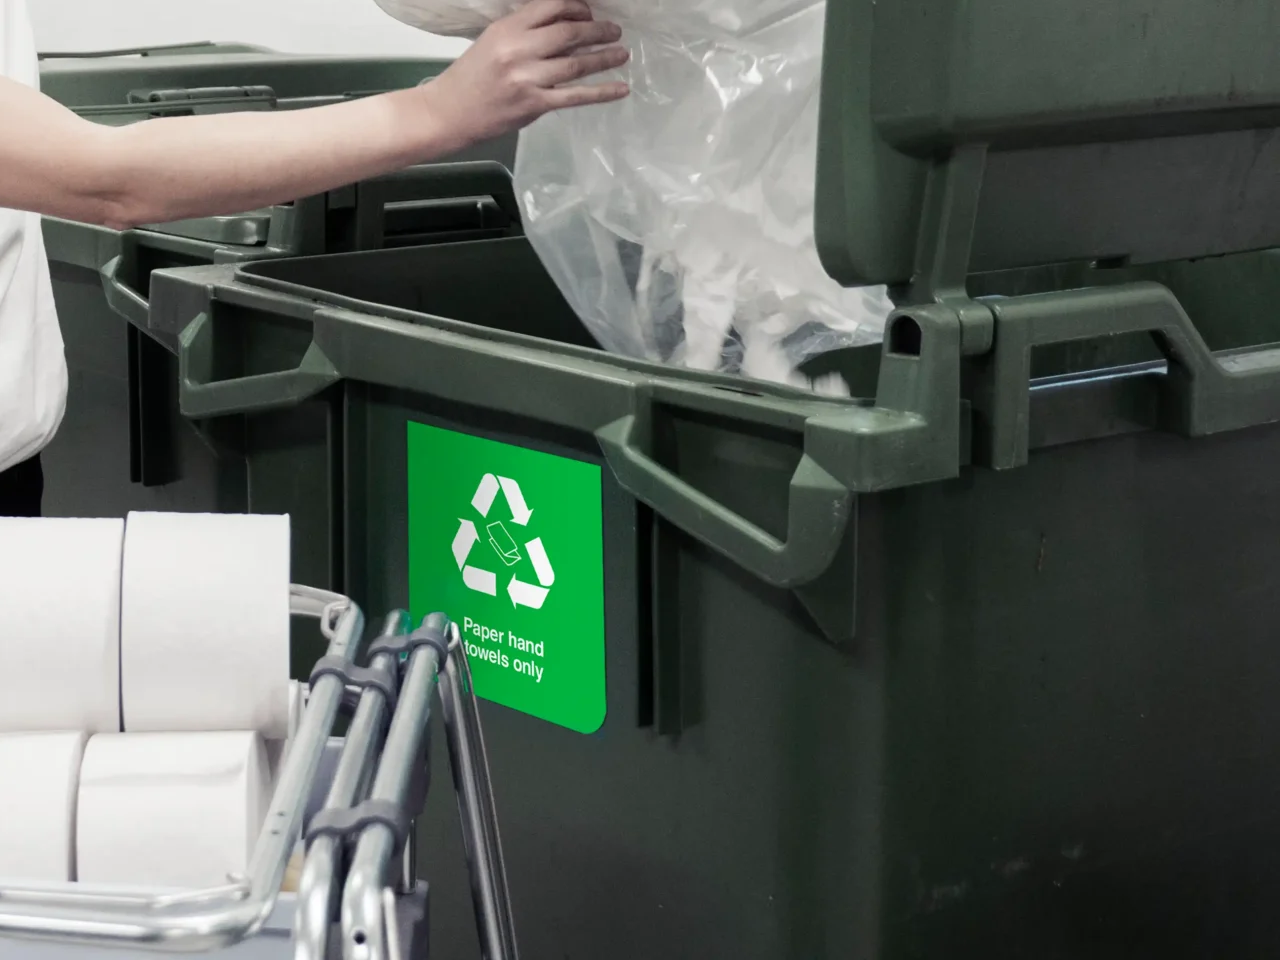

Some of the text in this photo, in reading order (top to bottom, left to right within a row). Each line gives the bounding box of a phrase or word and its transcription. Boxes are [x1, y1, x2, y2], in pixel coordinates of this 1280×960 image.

[464, 616, 544, 657] Paper hand
[464, 639, 544, 683] towels only
